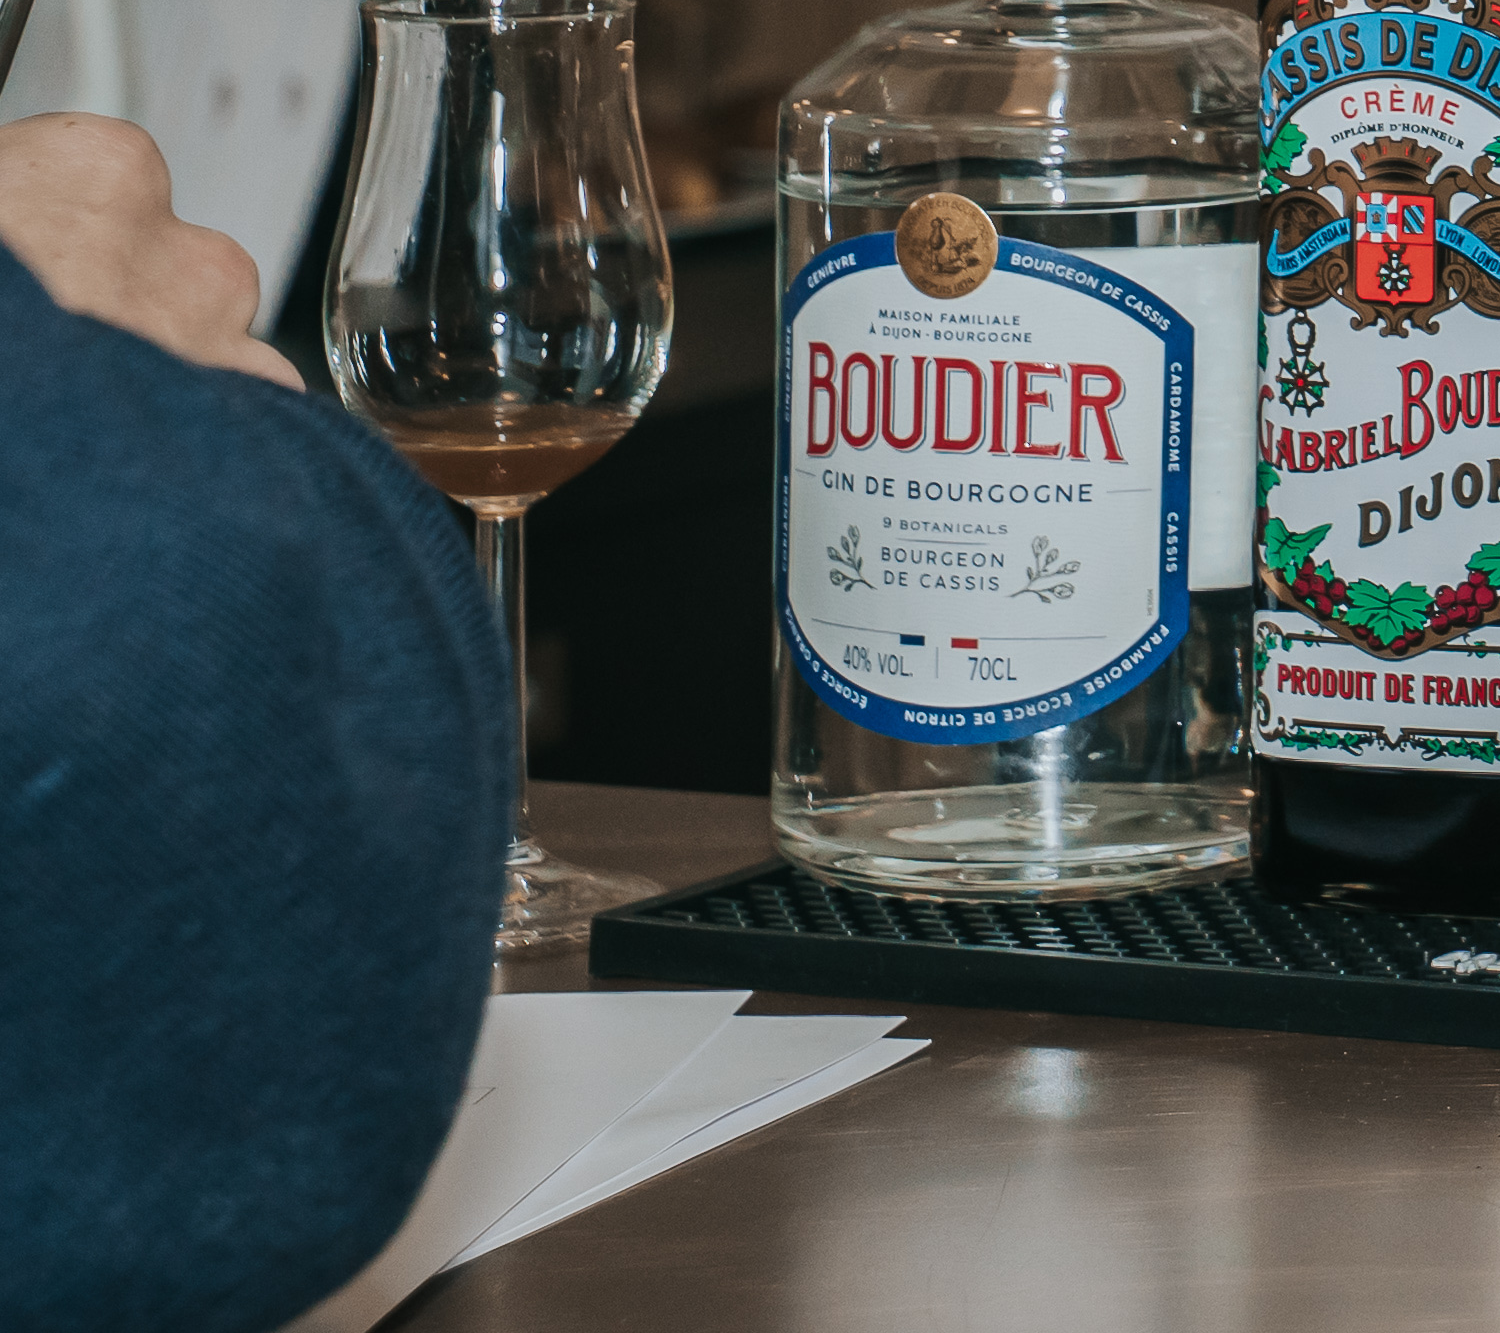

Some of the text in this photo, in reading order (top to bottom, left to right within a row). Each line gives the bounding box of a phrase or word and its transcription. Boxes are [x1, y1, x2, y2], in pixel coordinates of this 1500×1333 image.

[1379, 18, 1439, 71] DE
[1340, 84, 1460, 126] CRÈME
[1389, 123, 1465, 151] D'HONNEUR
[1438, 223, 1466, 249] LYON
[1010, 252, 1172, 332] BOURGEON DE CASSIS
[878, 309, 1021, 326] MAISON FAMILIALE
[934, 330, 1032, 343] BOURGOGNE
[806, 341, 1127, 463] BOUDIER
[1168, 362, 1183, 473] CARDAMOME
[1257, 384, 1402, 473] GABRIEL
[822, 469, 1093, 503] GIN DE BOURGOGNE
[883, 517, 1008, 535] 9 BOTANICALS
[1165, 511, 1179, 573] CASSIS
[881, 547, 1005, 568] BOURGEON
[884, 571, 1000, 591] DE CASSIS
[843, 644, 913, 677] 40% VOL.
[968, 656, 1017, 681] 70CL
[1083, 624, 1170, 695] FRAMBOISE
[1277, 663, 1375, 702] PRODUIT
[1384, 672, 1415, 704] DE
[904, 710, 966, 727] CITRON
[974, 711, 996, 726] DE
